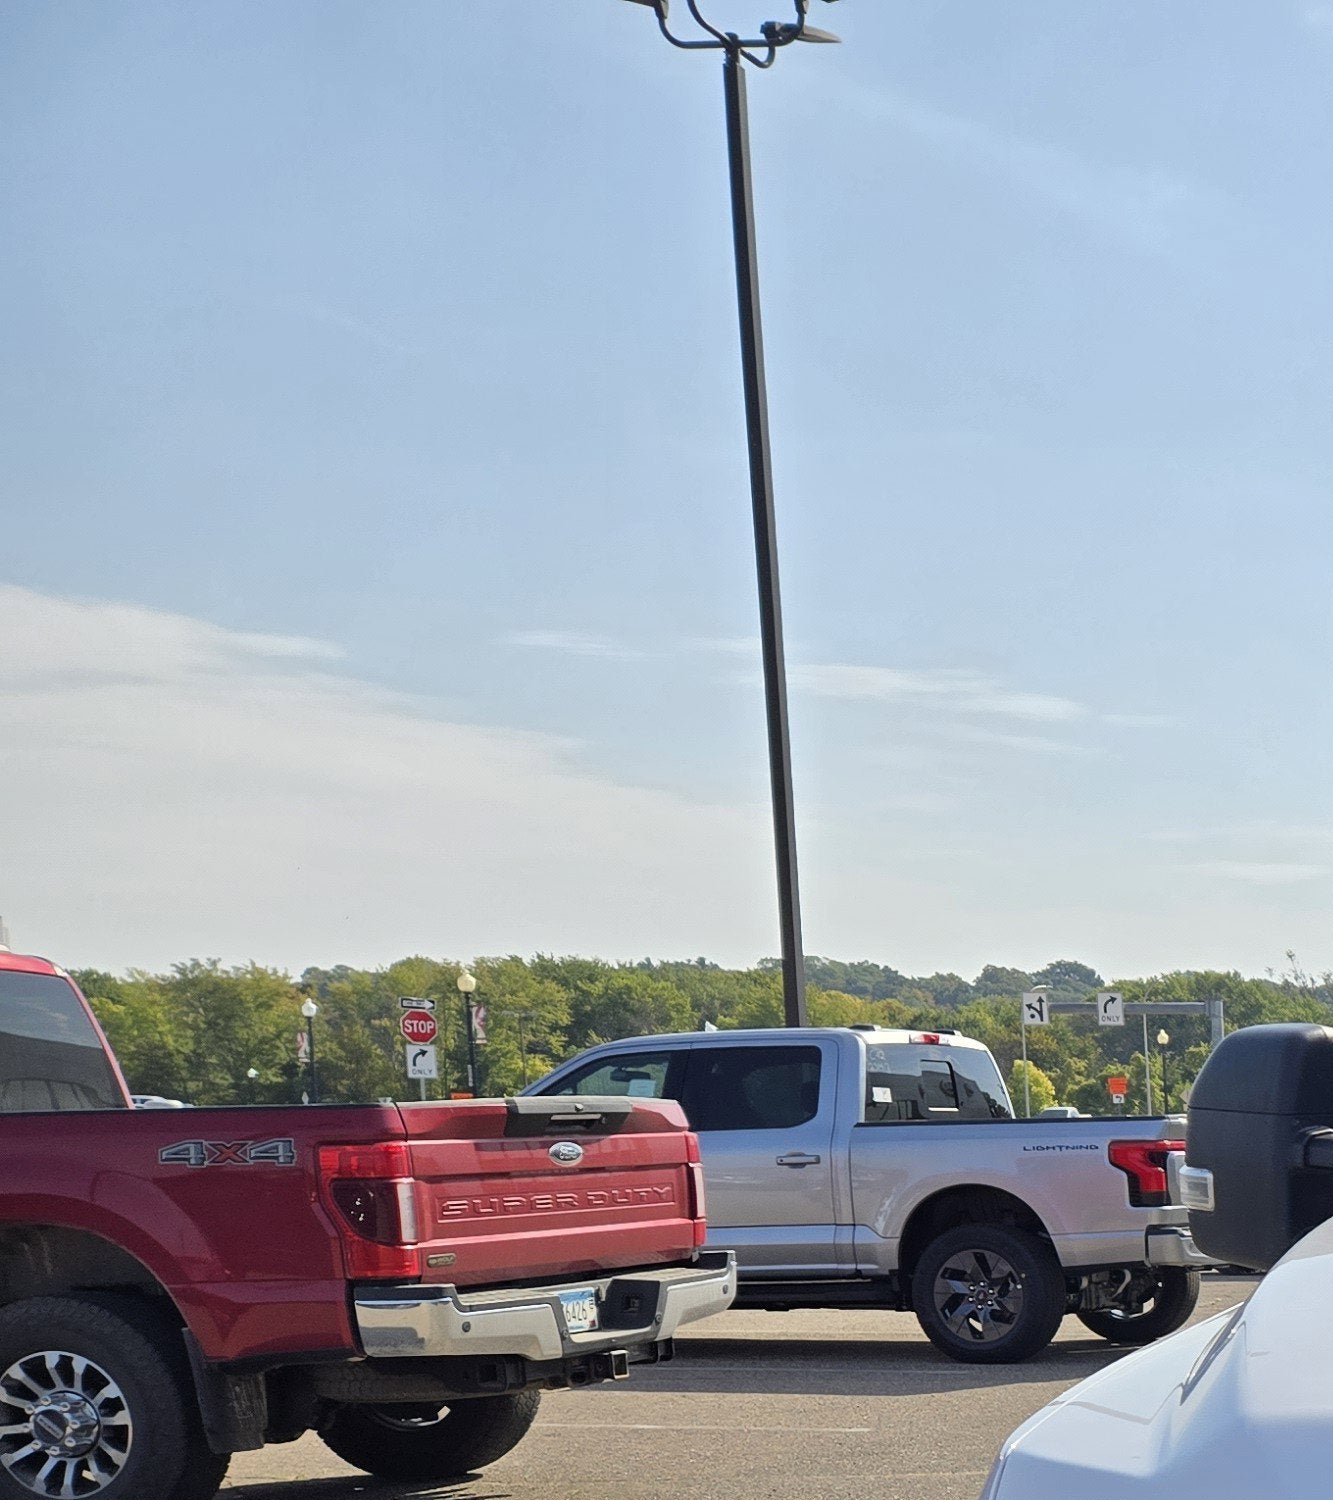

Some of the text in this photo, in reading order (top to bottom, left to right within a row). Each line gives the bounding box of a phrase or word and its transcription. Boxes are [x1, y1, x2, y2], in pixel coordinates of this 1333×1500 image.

[1101, 1015, 1120, 1023] ONLY
[404, 1019, 434, 1034] STOP
[1023, 1144, 1099, 1152] LIGHTNING
[442, 1186, 672, 1216] SUPER DUTY
